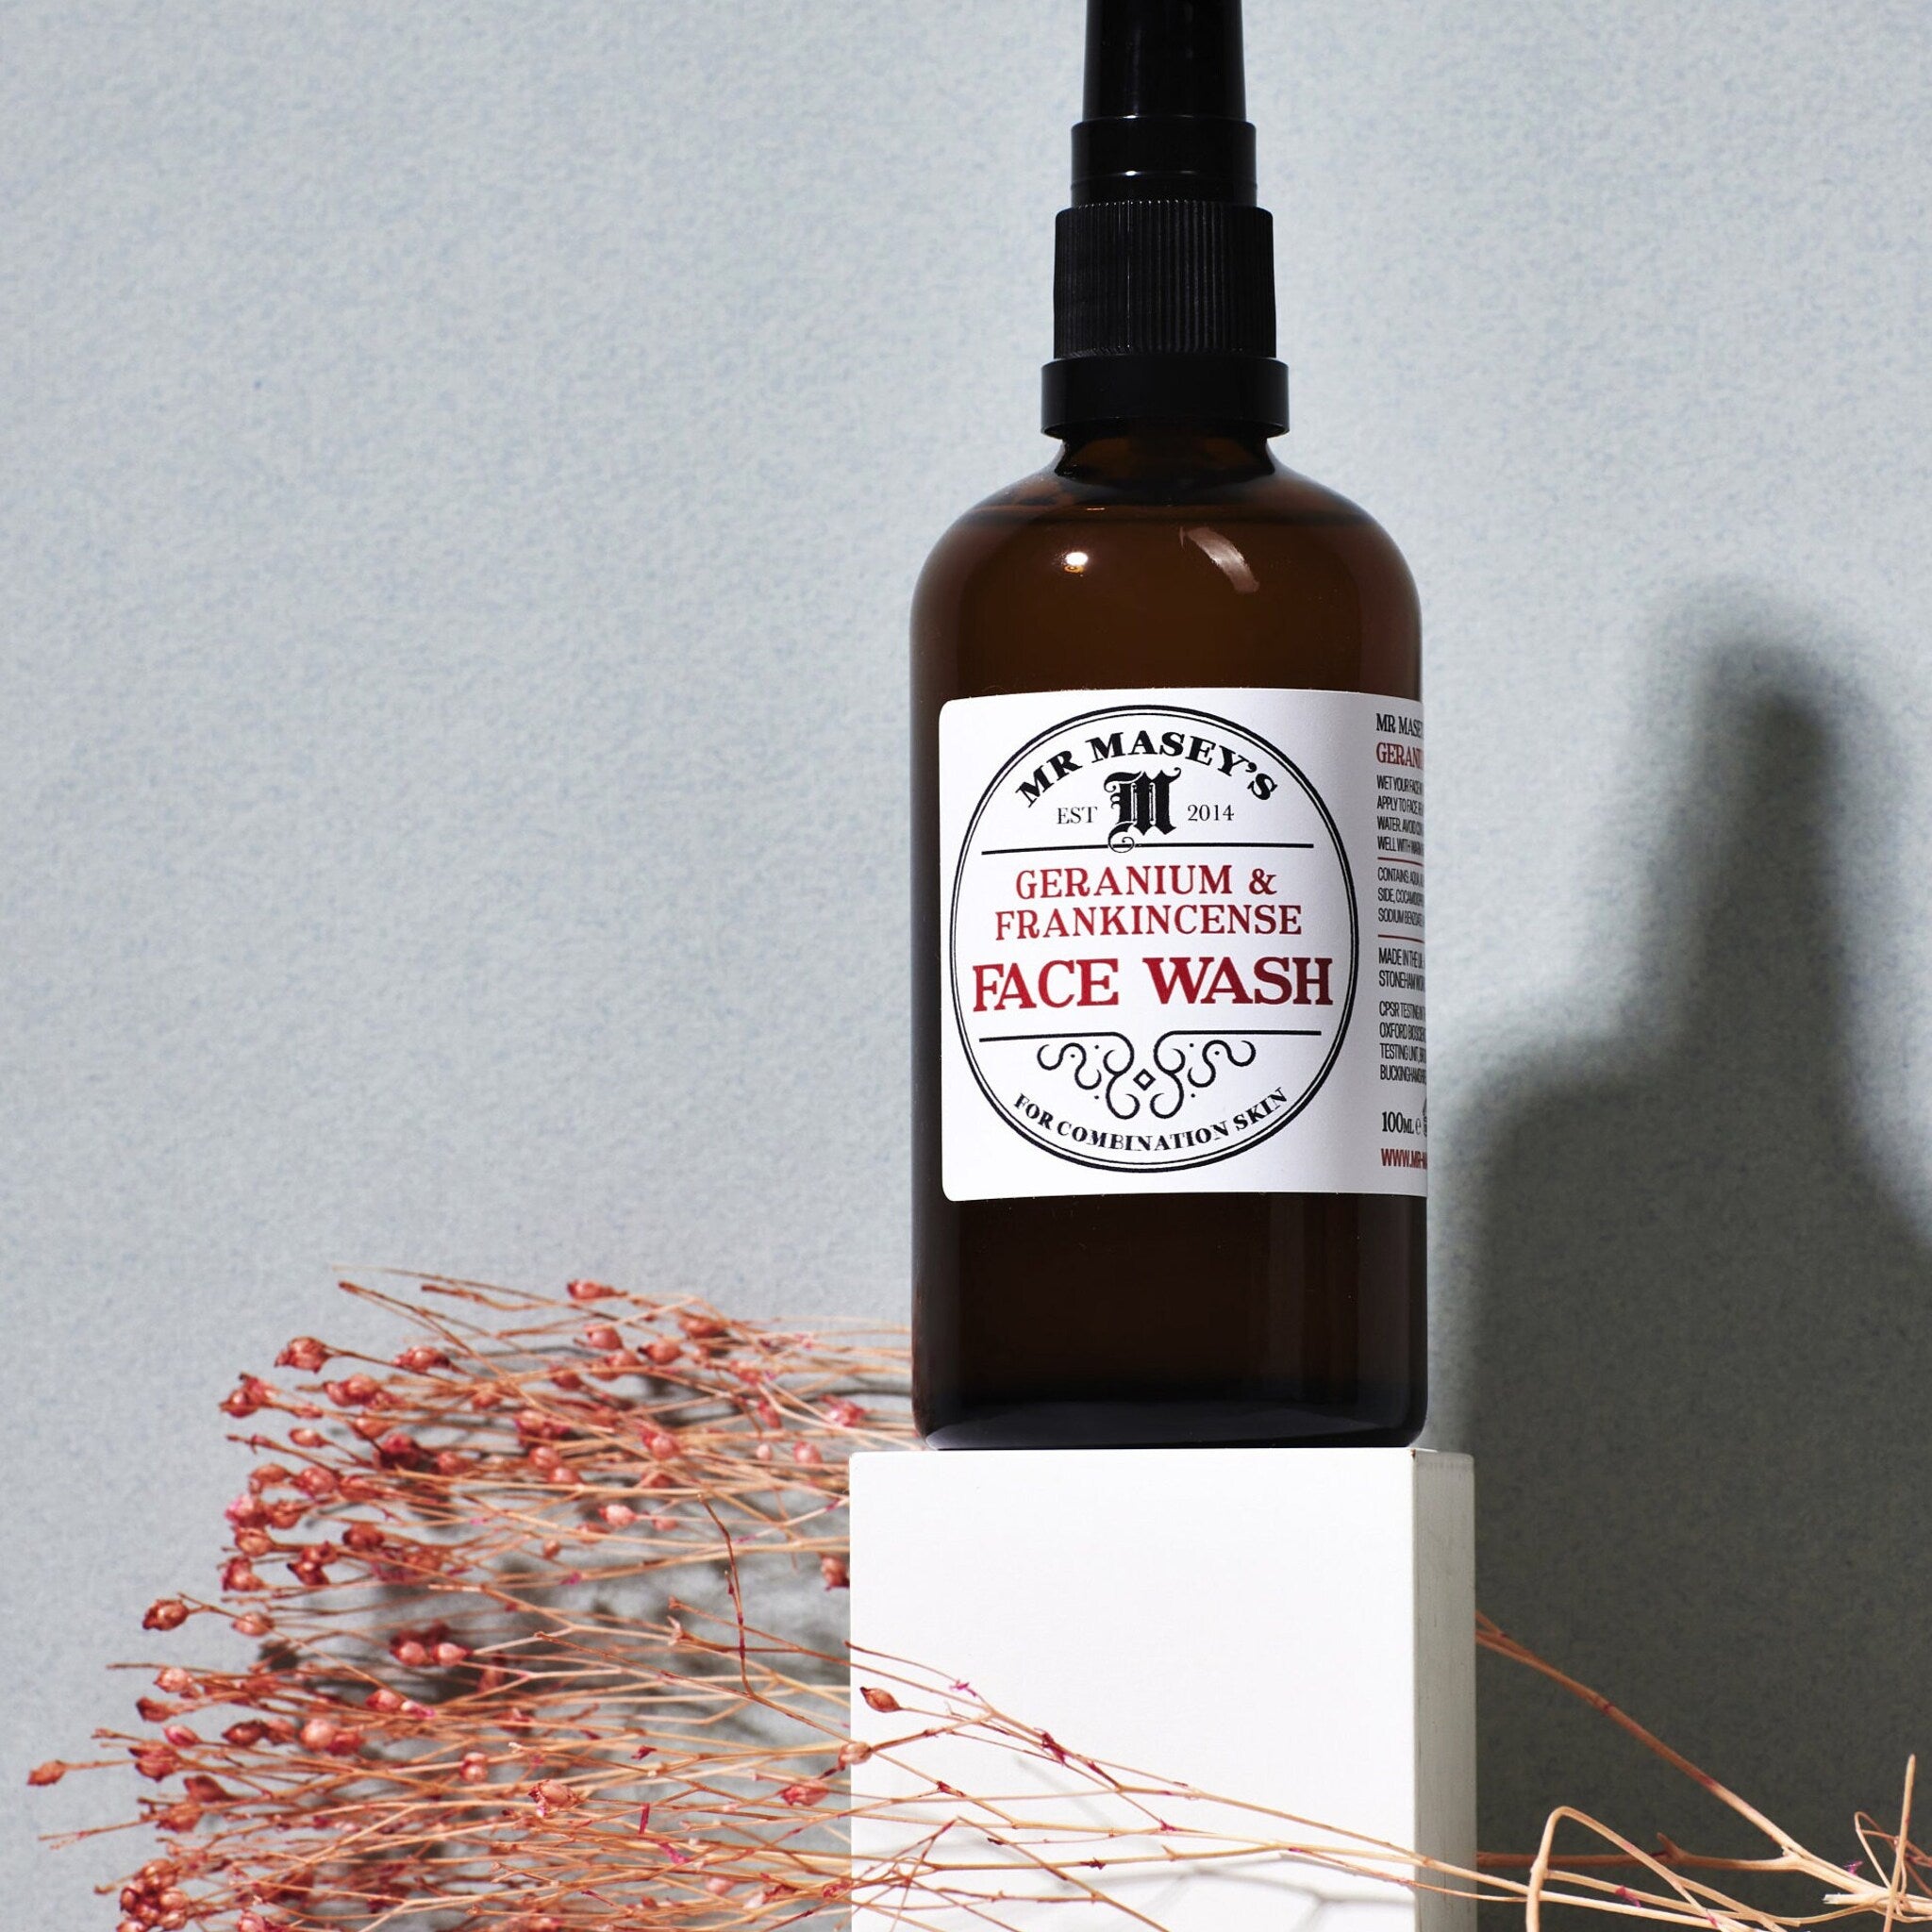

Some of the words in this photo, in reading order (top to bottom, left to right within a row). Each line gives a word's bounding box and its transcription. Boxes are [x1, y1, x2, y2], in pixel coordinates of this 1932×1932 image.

[1376, 712, 1396, 734] MR
[1015, 750, 1083, 808] MR
[1085, 730, 1277, 801] MASEY'S
[1377, 795, 1397, 811] APPLY
[1056, 806, 1098, 824] EST
[1187, 805, 1235, 822] 2014
[1377, 836, 1396, 851] WELL
[1015, 865, 1233, 899] GERANIUM
[1248, 868, 1277, 895] &
[995, 905, 1302, 941] FRANKINCENSE
[1378, 947, 1401, 965] MADE
[973, 958, 1120, 1012] FACE
[1142, 957, 1333, 1006] WASH
[1379, 1000, 1399, 1017] CPSR
[1379, 1022, 1407, 1040] OXFORD
[1379, 1043, 1407, 1060] TESTING
[1013, 1093, 1055, 1130] FOR
[1057, 1120, 1230, 1152] COMBINATION
[1233, 1087, 1289, 1131] SKIN
